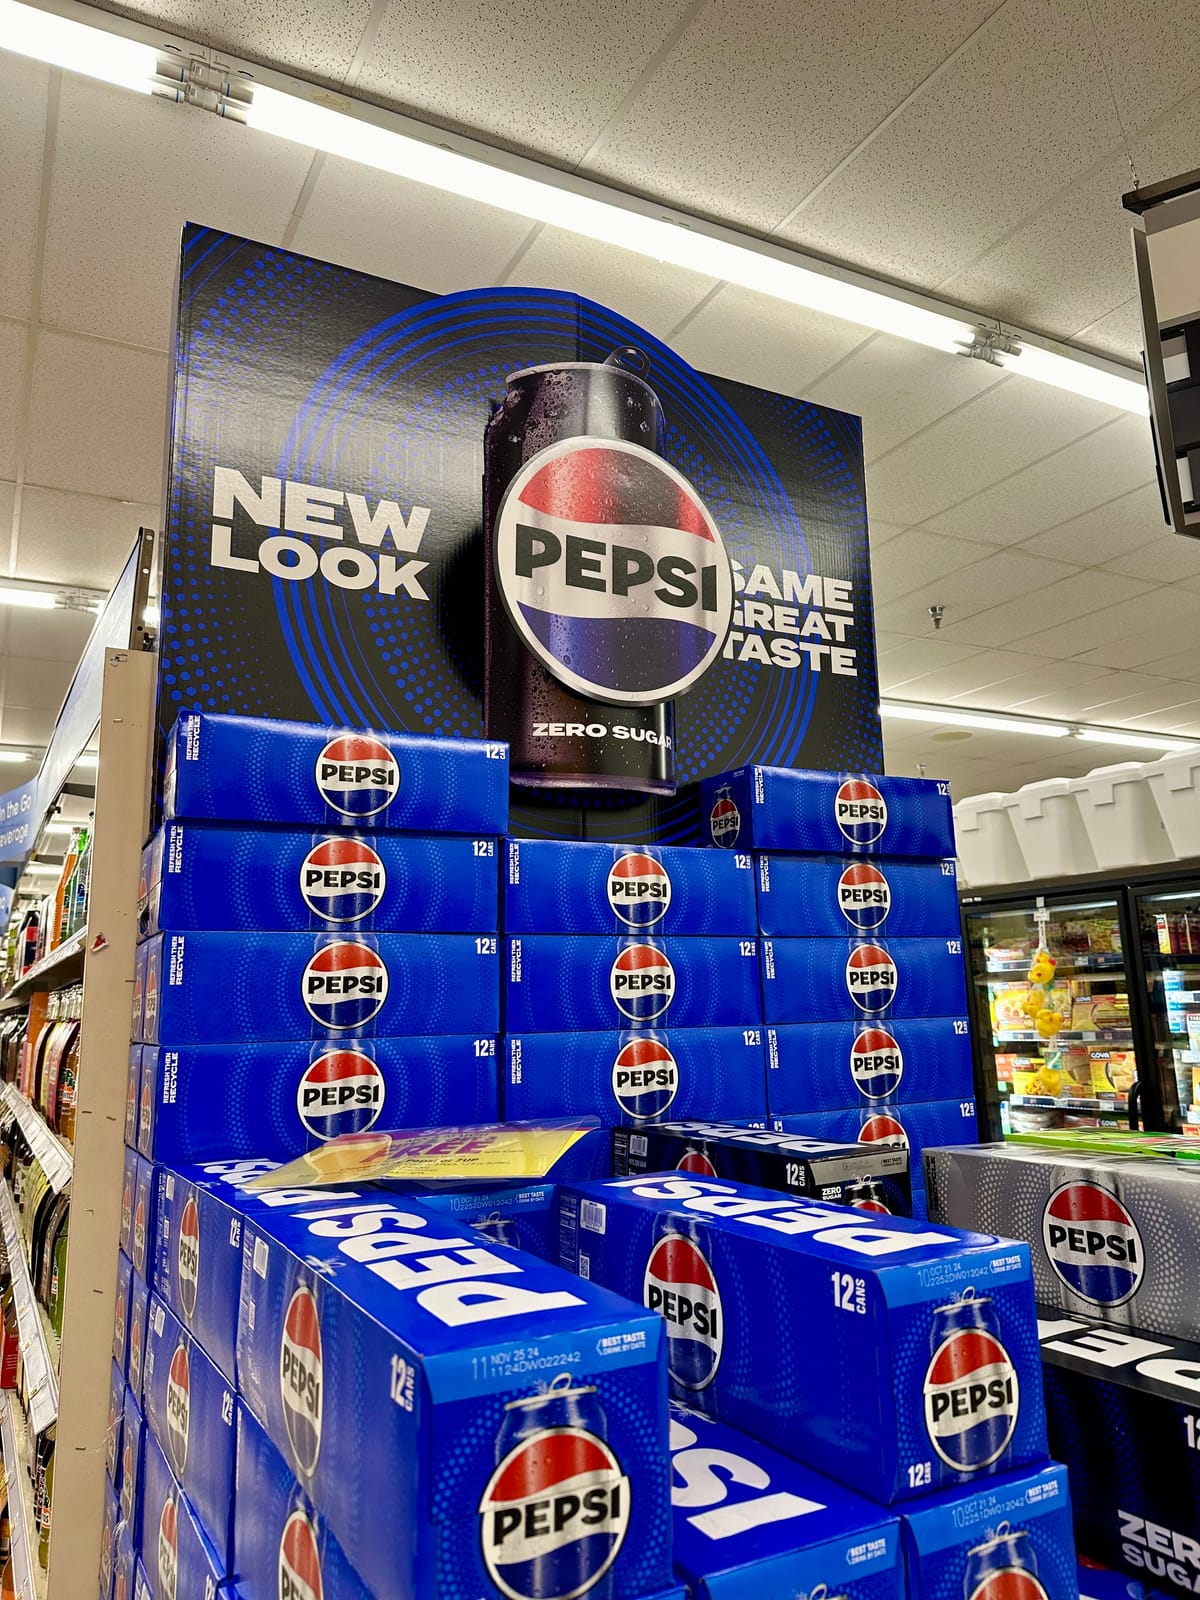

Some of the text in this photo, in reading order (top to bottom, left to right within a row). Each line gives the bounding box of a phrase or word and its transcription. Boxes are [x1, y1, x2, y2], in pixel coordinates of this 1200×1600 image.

[212, 466, 431, 553] NEW
[210, 523, 431, 601] LOOK
[515, 523, 717, 612] PEPSI
[723, 631, 857, 676] TASTE
[532, 722, 672, 750] ZERO SUGAR
[485, 743, 499, 760] 12
[321, 763, 395, 786] PEPSI
[937, 782, 947, 796] 12
[838, 803, 885, 819] PEPSI
[712, 814, 739, 830] PEPSI
[472, 840, 487, 856] 12
[734, 854, 746, 869] 12
[940, 862, 950, 876] 12
[305, 869, 380, 889] PEPSI
[611, 881, 667, 898] PEPSI
[841, 888, 887, 903] PEPSI
[475, 937, 490, 955] 12
[739, 941, 752, 956] 12
[946, 940, 957, 954] 12
[307, 975, 383, 994] PEPSI
[614, 974, 671, 990] PEPSI
[849, 970, 894, 985] PEPSI
[953, 1020, 964, 1034] 12
[742, 1030, 756, 1046] 12
[473, 1039, 489, 1057] 12
[853, 1055, 900, 1072] PEPSI
[616, 1069, 674, 1088] PEPSI
[303, 1083, 380, 1107] PEPSI
[960, 1102, 970, 1117] 12
[786, 1162, 806, 1187] 12 CANS
[822, 1186, 841, 1196] ZERO
[602, 1176, 961, 1257] PEPSI
[1048, 1224, 1137, 1264] PEPSI
[180, 1239, 198, 1278] PEPSI
[290, 1203, 588, 1327] PEPSI
[993, 1258, 1005, 1268] BEST
[918, 1268, 930, 1288] 10
[930, 1265, 942, 1276] OCT
[943, 1264, 951, 1273] 21
[831, 1271, 867, 1315] 12 CANS
[648, 1284, 718, 1339] PEPSI
[602, 1331, 646, 1347] BEST TASTE
[472, 1347, 539, 1380] 11 NOV 25 24
[282, 1344, 321, 1419] PEPSI
[390, 1354, 415, 1412] 12 CANS
[168, 1385, 188, 1434] PEPSI
[931, 1378, 1014, 1422] PEPSI
[908, 1463, 924, 1488] 12
[493, 1484, 621, 1546] PEPSI
[952, 1506, 965, 1528] 10
[964, 1501, 977, 1514] OCT
